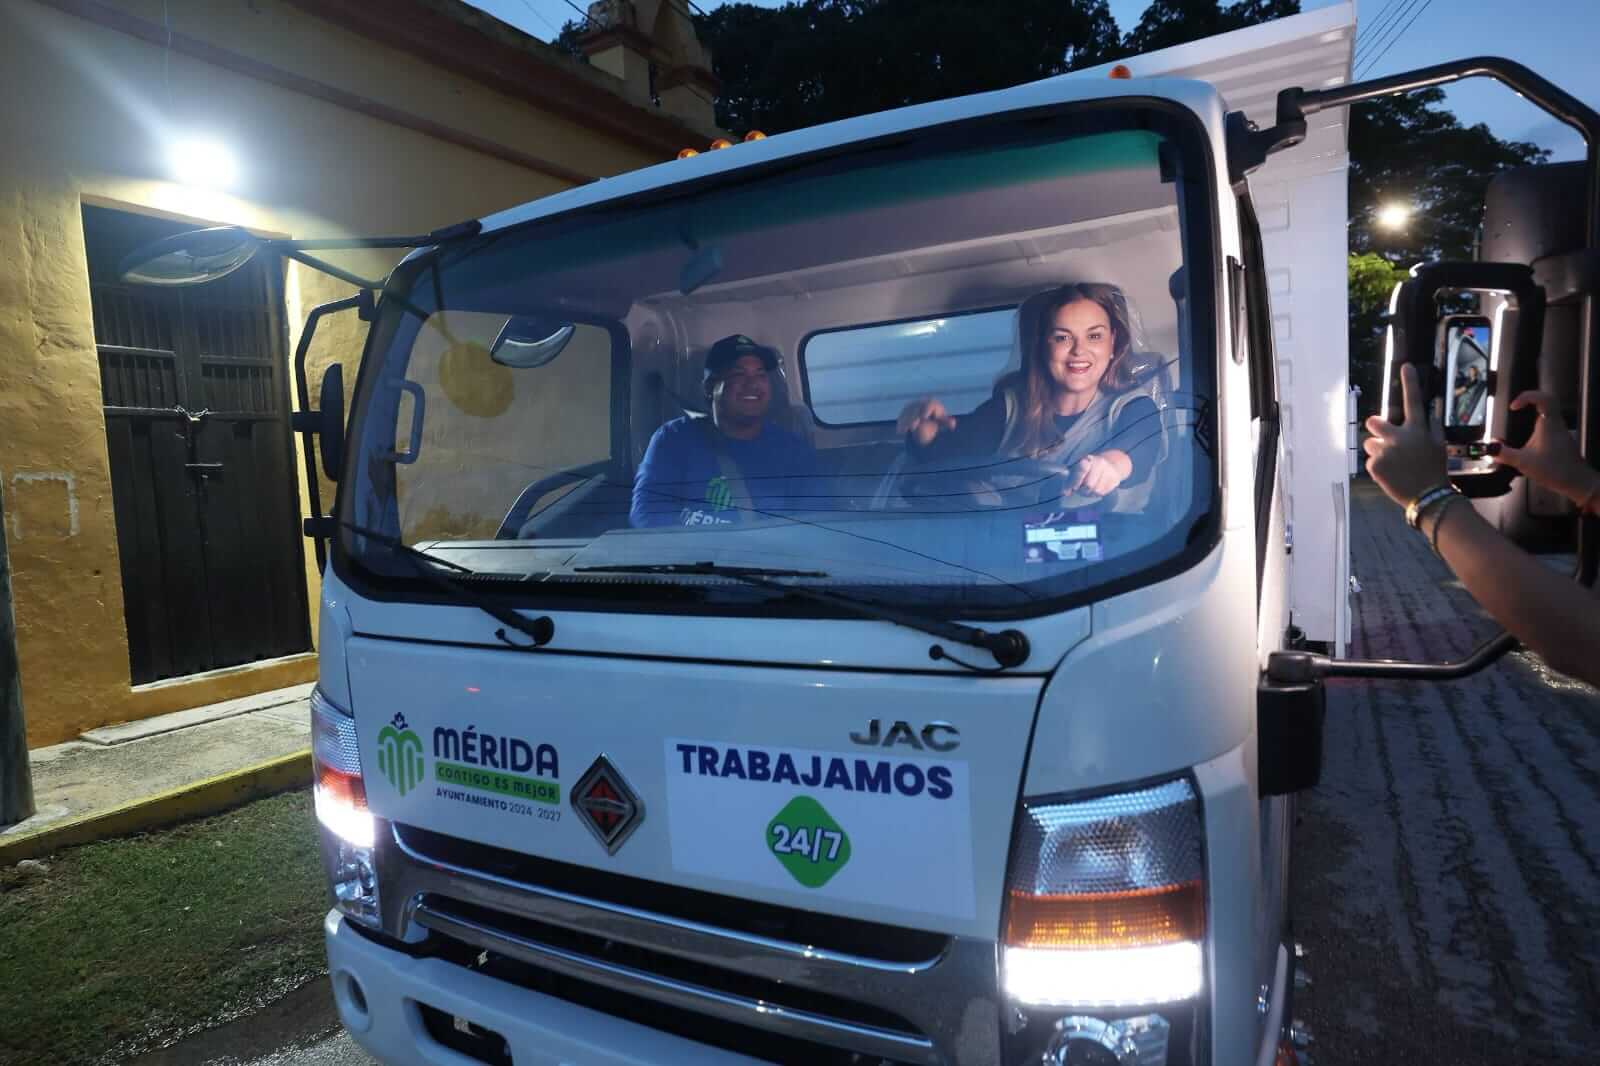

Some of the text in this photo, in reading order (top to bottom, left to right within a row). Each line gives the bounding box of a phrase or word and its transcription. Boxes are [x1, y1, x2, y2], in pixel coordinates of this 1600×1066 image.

[433, 726, 559, 778] MÉRIDA
[850, 718, 960, 752] JAC
[437, 767, 556, 799] CONTIGO ES MEJOR
[676, 744, 953, 800] TRABAJAMOS
[436, 788, 508, 811] AYUNTAMIENTO
[772, 824, 843, 863] 24/7
